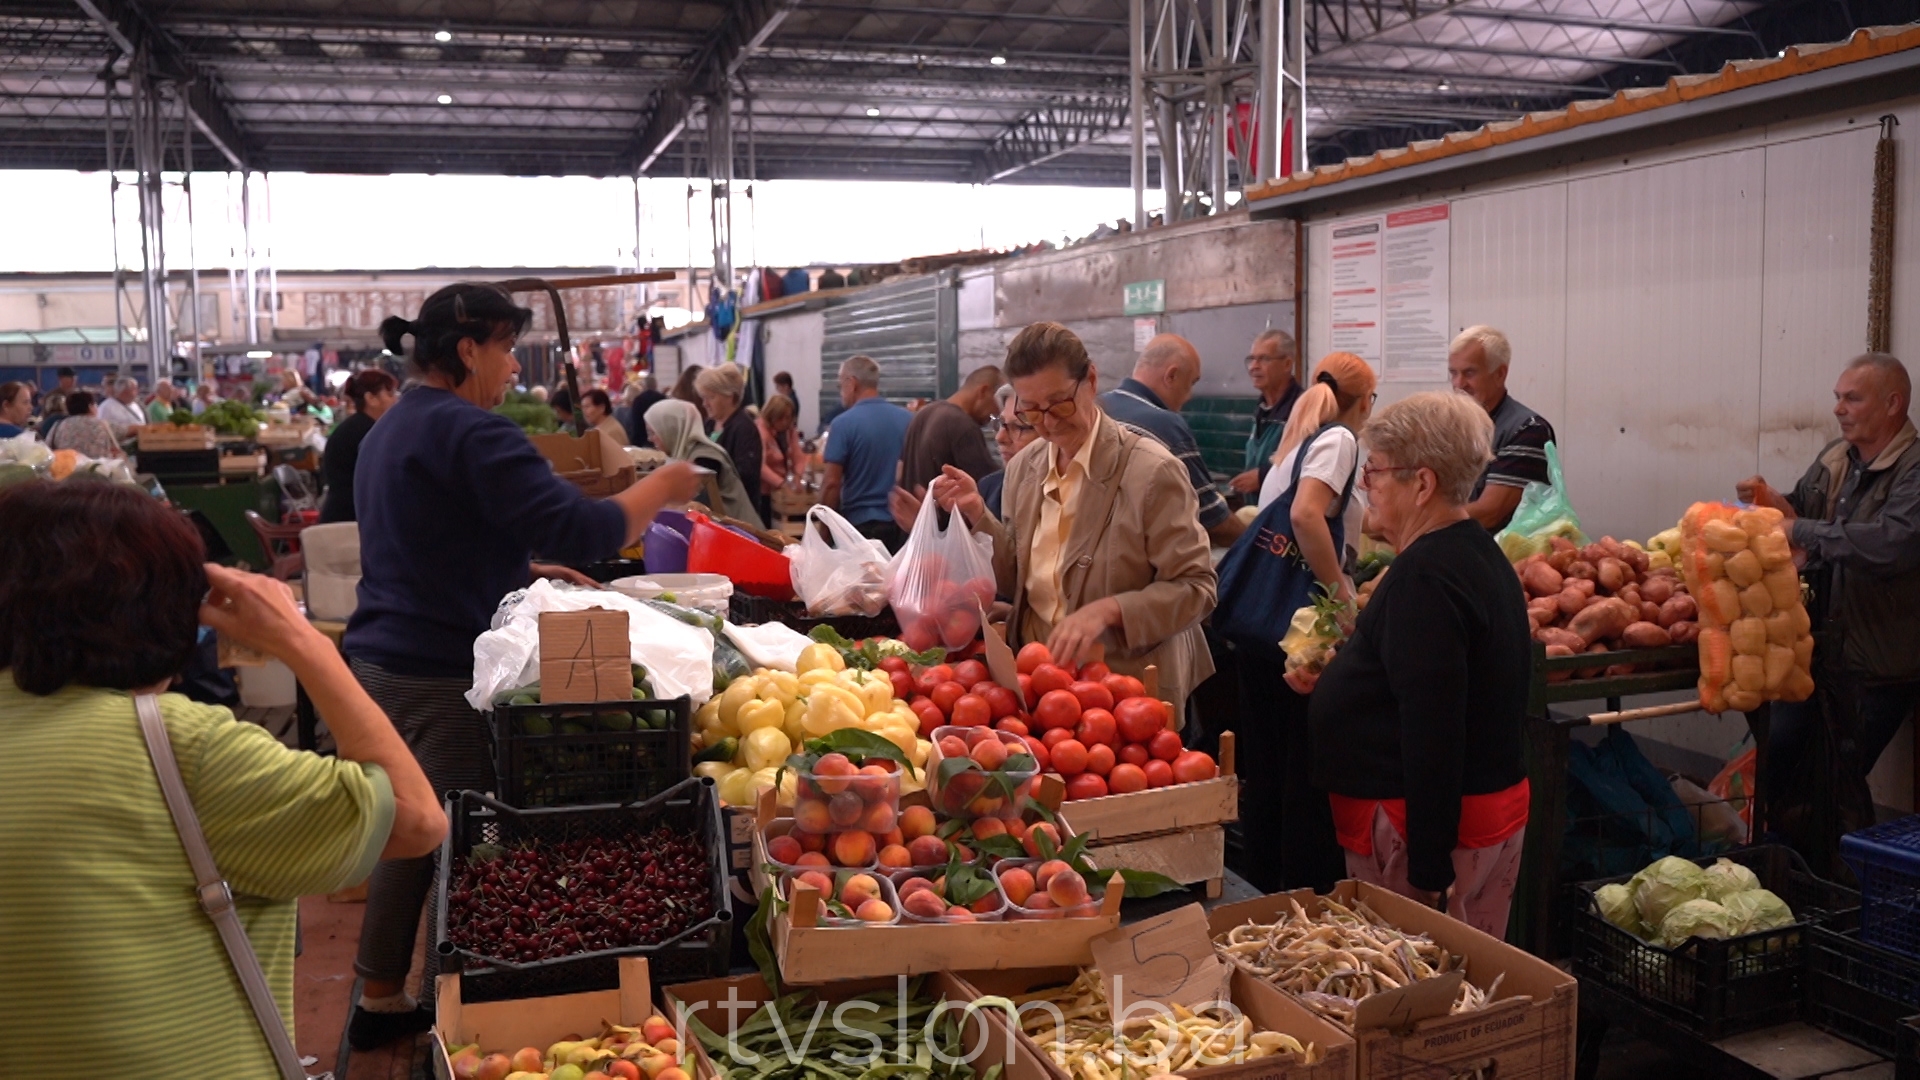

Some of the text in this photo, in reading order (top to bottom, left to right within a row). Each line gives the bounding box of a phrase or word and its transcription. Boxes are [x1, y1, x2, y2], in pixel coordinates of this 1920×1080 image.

[1131, 919, 1190, 998] 5
[1424, 1013, 1525, 1049] PRODUCT OF ECUADOR
